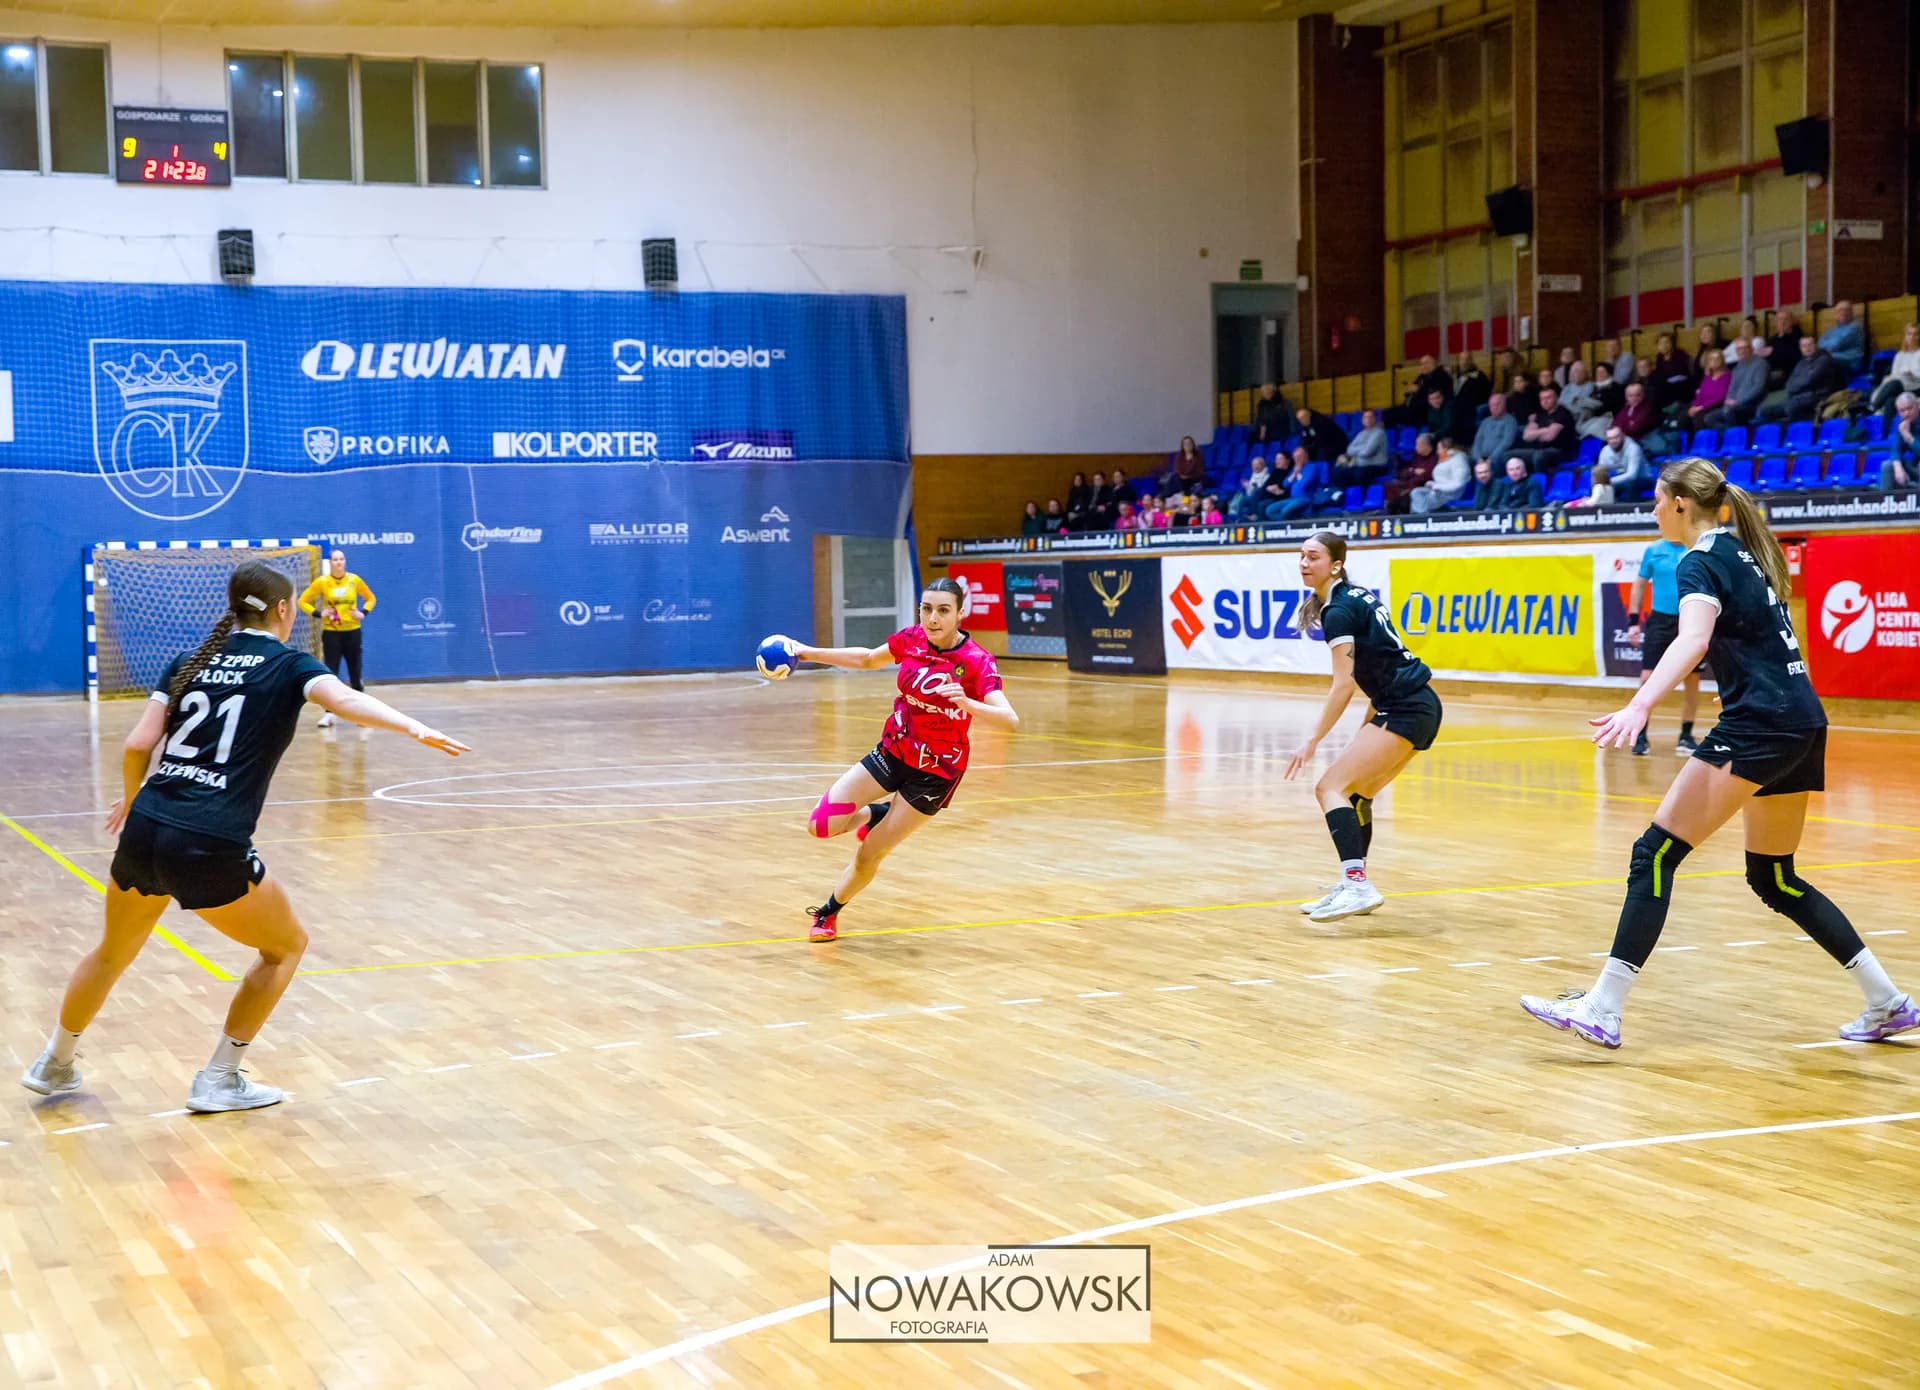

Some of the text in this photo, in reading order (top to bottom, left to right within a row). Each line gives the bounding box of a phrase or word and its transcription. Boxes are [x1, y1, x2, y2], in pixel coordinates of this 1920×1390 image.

[122, 137, 137, 158] 9
[213, 142, 228, 161] 4
[357, 337, 567, 379] LEWIATAN
[652, 344, 770, 369] karabela
[111, 409, 225, 498] CK
[342, 435, 451, 456] PROFIKA
[511, 431, 658, 458] KOLPORTER
[1770, 494, 1920, 519] www.koronahandball.
[604, 523, 689, 535] ALUTOR
[720, 526, 791, 543] Aswent
[1435, 588, 1580, 635] LEWIATAN
[1876, 591, 1908, 608] LIGA
[1213, 588, 1330, 640] SUZ
[1876, 630, 1920, 648] KOBIE
[221, 654, 265, 668] ZPRP
[912, 667, 948, 695] 10
[165, 690, 246, 765] 21
